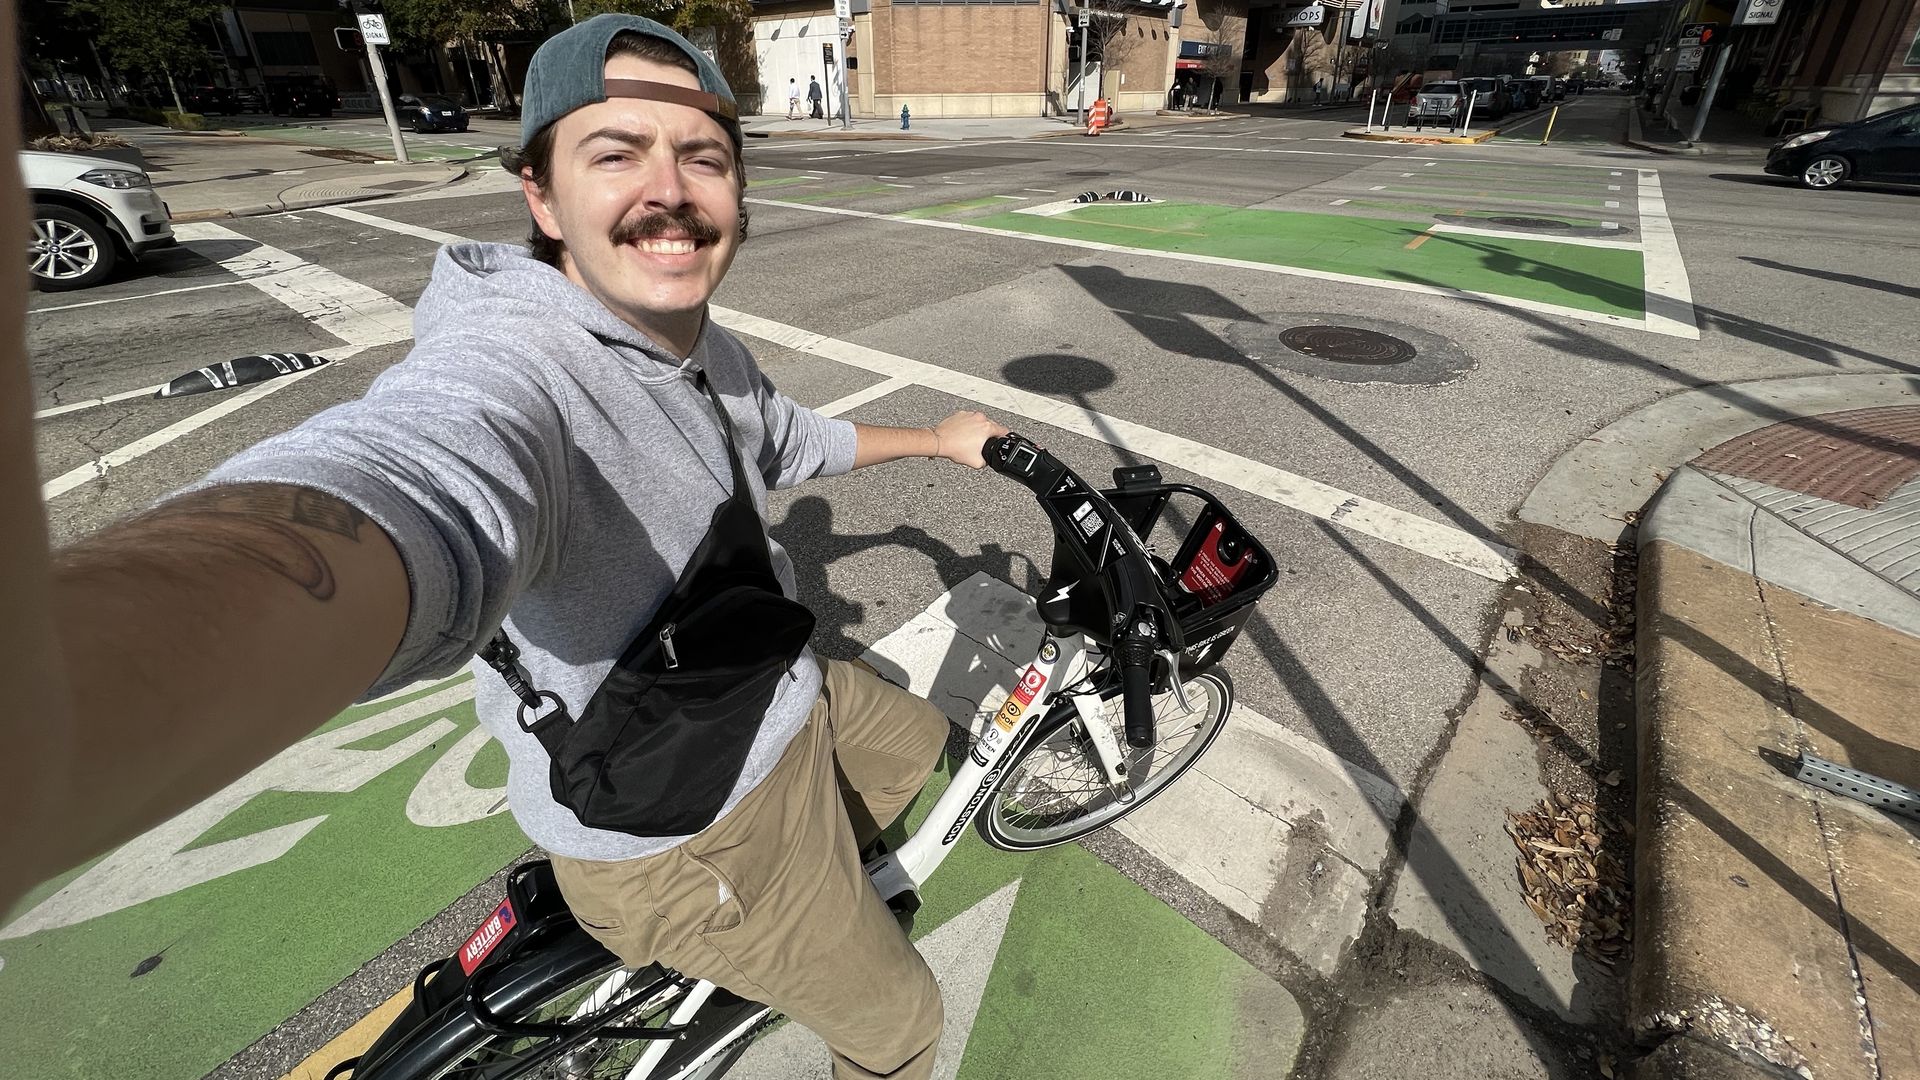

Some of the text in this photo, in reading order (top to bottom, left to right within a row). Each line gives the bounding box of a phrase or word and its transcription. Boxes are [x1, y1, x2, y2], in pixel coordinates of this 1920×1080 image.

[1288, 11, 1320, 22] SHOPS
[1748, 11, 1774, 19] SIGNAL
[1019, 681, 1035, 696] STOP
[980, 738, 996, 753] ISTEN
[945, 788, 986, 841] HOUSTON
[466, 916, 502, 962] BATTERY
[476, 929, 503, 960] CHECK MY
